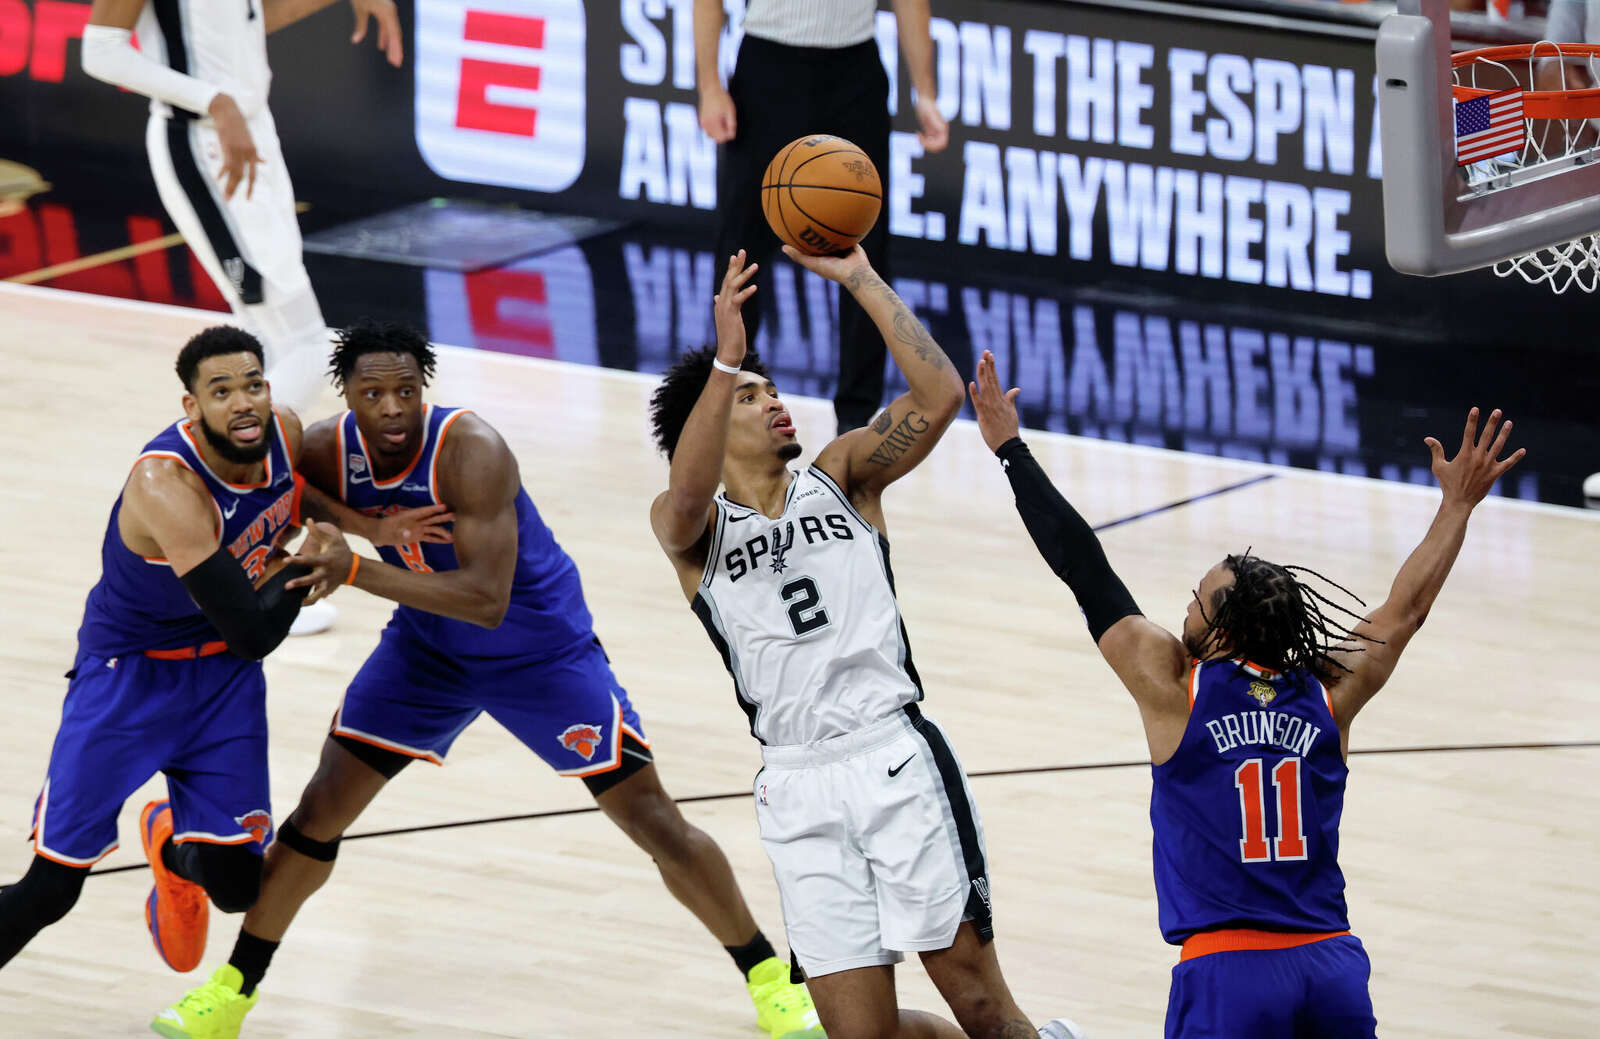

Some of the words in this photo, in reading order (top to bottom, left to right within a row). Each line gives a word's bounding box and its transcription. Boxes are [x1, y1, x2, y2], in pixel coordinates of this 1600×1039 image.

[455, 10, 546, 138] E
[1024, 29, 1155, 150] THE
[1168, 47, 1356, 176] ESPN
[958, 140, 1373, 300] ANYWHERE.
[725, 514, 854, 583] SPURS
[778, 574, 832, 639] 2
[1205, 710, 1321, 758] BRUNSON
[1234, 756, 1309, 864] 11
